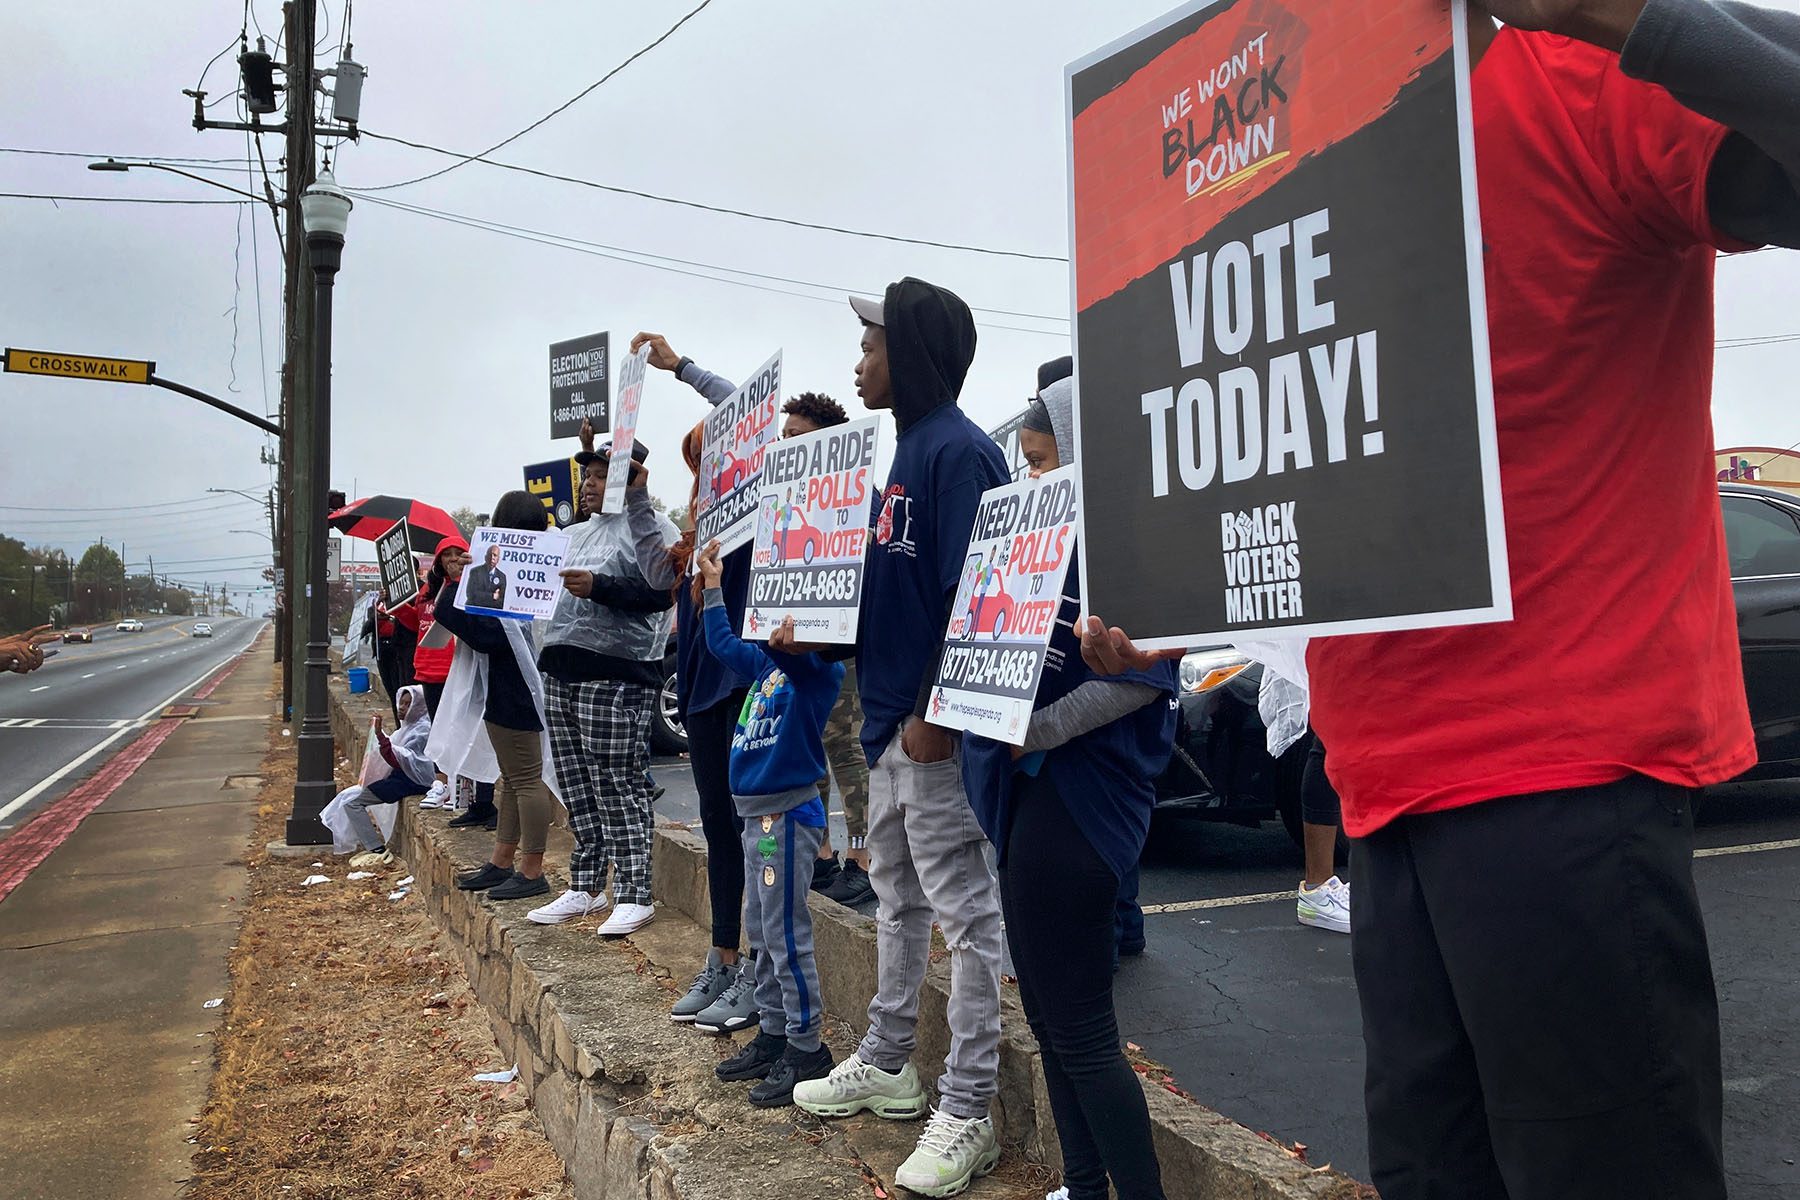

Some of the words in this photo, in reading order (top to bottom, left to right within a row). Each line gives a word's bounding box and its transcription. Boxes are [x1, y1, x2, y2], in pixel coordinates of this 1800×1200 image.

[1162, 87, 1193, 128] WE
[1198, 31, 1268, 104] WON'T
[1162, 54, 1288, 179] BLACK
[1186, 115, 1276, 196] DOWN
[1169, 208, 1336, 369] VOTE
[28, 356, 128, 377] CROSSWALK
[552, 351, 590, 374] ELECTION
[590, 350, 604, 361] YOU
[552, 370, 590, 389] PROTECTION
[590, 369, 604, 379] VOTE
[553, 402, 606, 423] 1-866-OUR-VOTE
[570, 391, 586, 404] CALL
[702, 401, 735, 451] NEED
[735, 391, 746, 424] A
[747, 359, 780, 408] RIDE
[734, 393, 776, 451] POLLS
[1141, 330, 1386, 498] TODAY!
[755, 430, 764, 446] TO
[763, 443, 808, 487] NEED
[808, 439, 822, 477] A
[827, 426, 875, 473] RIDE
[795, 491, 807, 505] the
[806, 467, 867, 512] POLLS
[798, 480, 806, 492] to
[697, 475, 763, 547] (877)524-868
[836, 508, 849, 526] TO
[971, 493, 1017, 543] NEED
[1016, 489, 1031, 533] A
[480, 532, 499, 543] WE
[499, 533, 537, 547] MUST
[821, 527, 866, 559] VOTE?
[997, 551, 1009, 567] the
[1006, 525, 1069, 576] POLLS
[1003, 536, 1011, 553] to
[384, 551, 408, 583] VOTERS
[502, 550, 562, 567] PROTECT
[755, 548, 771, 564] VOTE
[1223, 542, 1301, 587] VOTERS
[388, 573, 412, 603] MATTER
[517, 569, 546, 583] OUR
[751, 568, 856, 606] (877)524-8683
[1030, 573, 1043, 595] TO
[515, 586, 554, 601] VOTE!
[1225, 580, 1303, 624] MATTER
[949, 617, 965, 635] VOTE
[1010, 599, 1056, 637] VOTE?
[938, 644, 1038, 691] (877)524-8683
